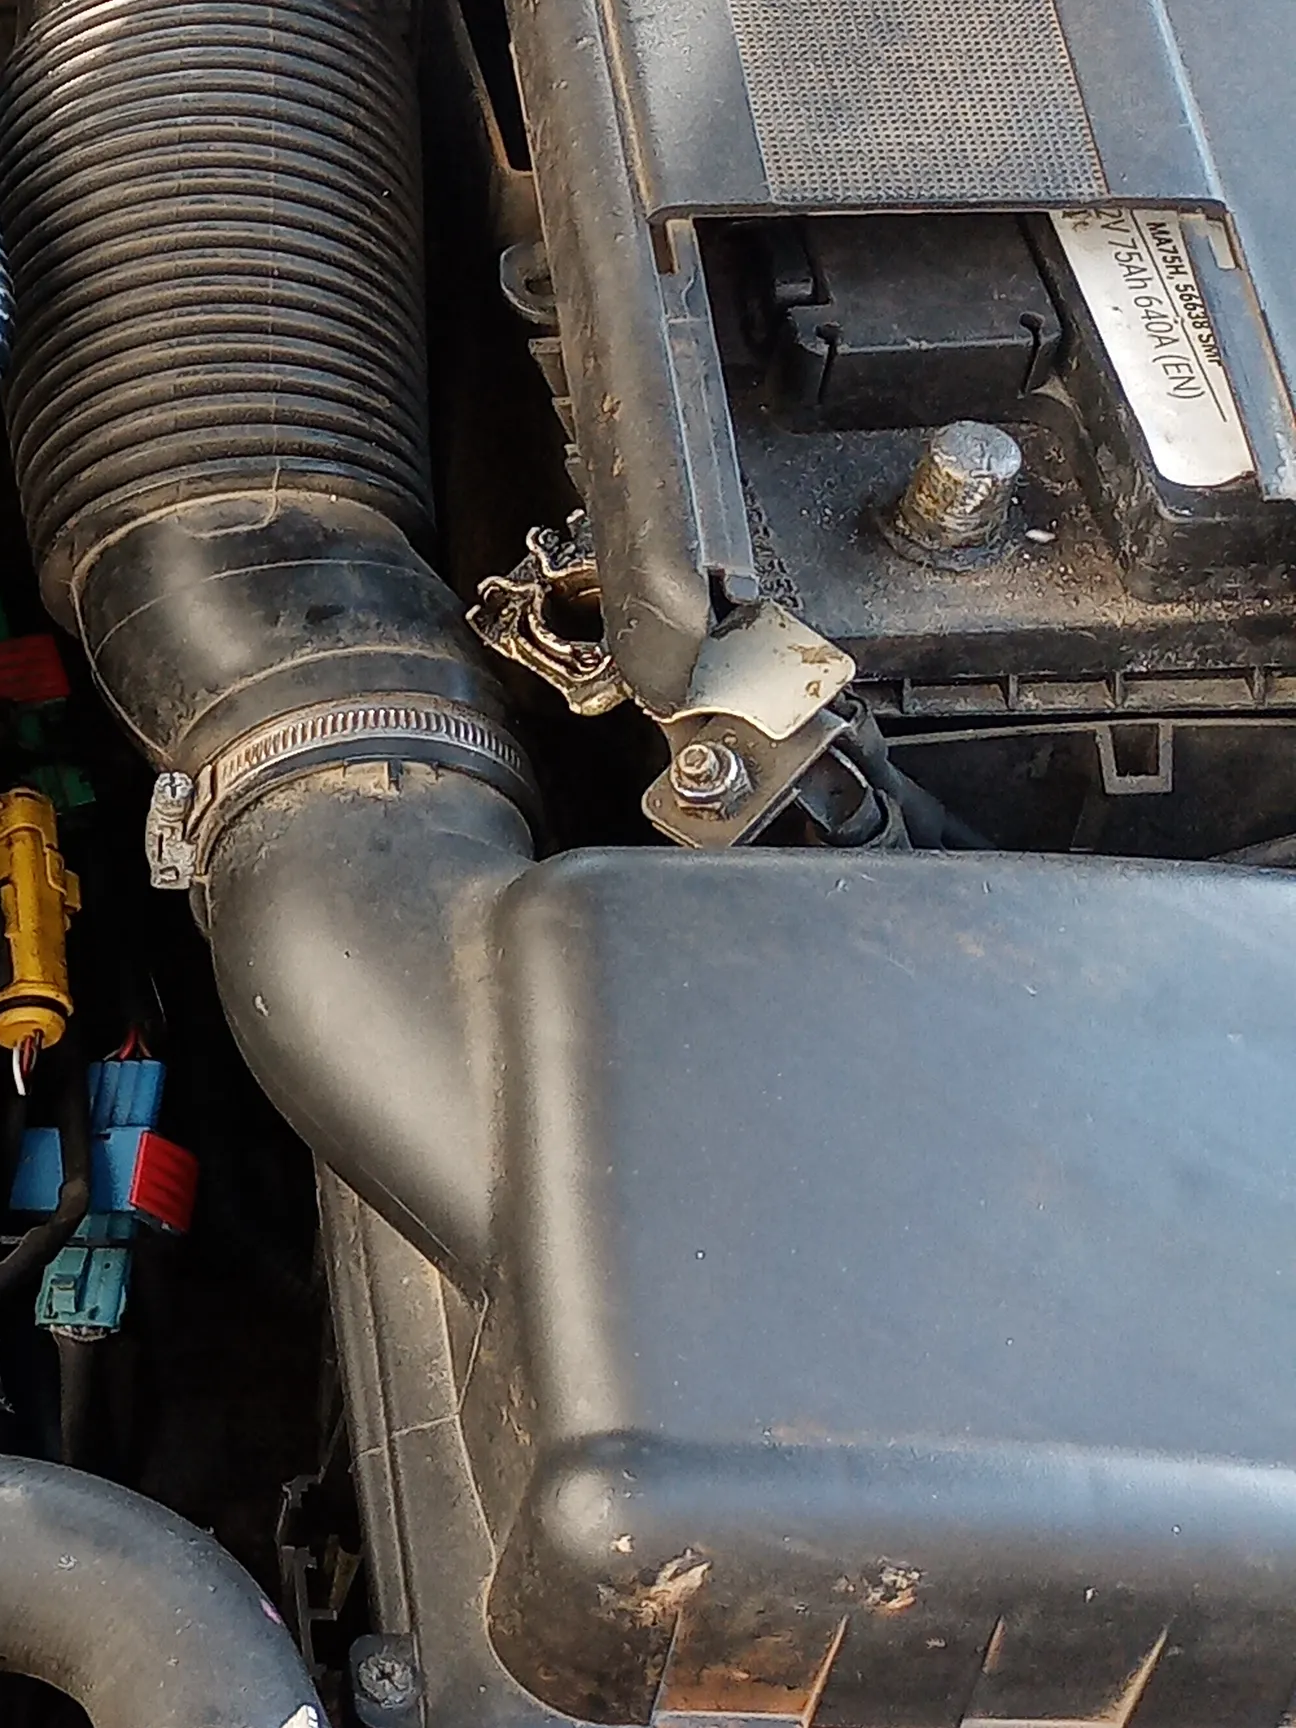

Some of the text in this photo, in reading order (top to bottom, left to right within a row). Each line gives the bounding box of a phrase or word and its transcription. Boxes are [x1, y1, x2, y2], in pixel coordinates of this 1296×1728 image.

[1095, 208, 1206, 400] 2V 75Ah 640A (EN)
[1174, 283, 1210, 330] 56638
